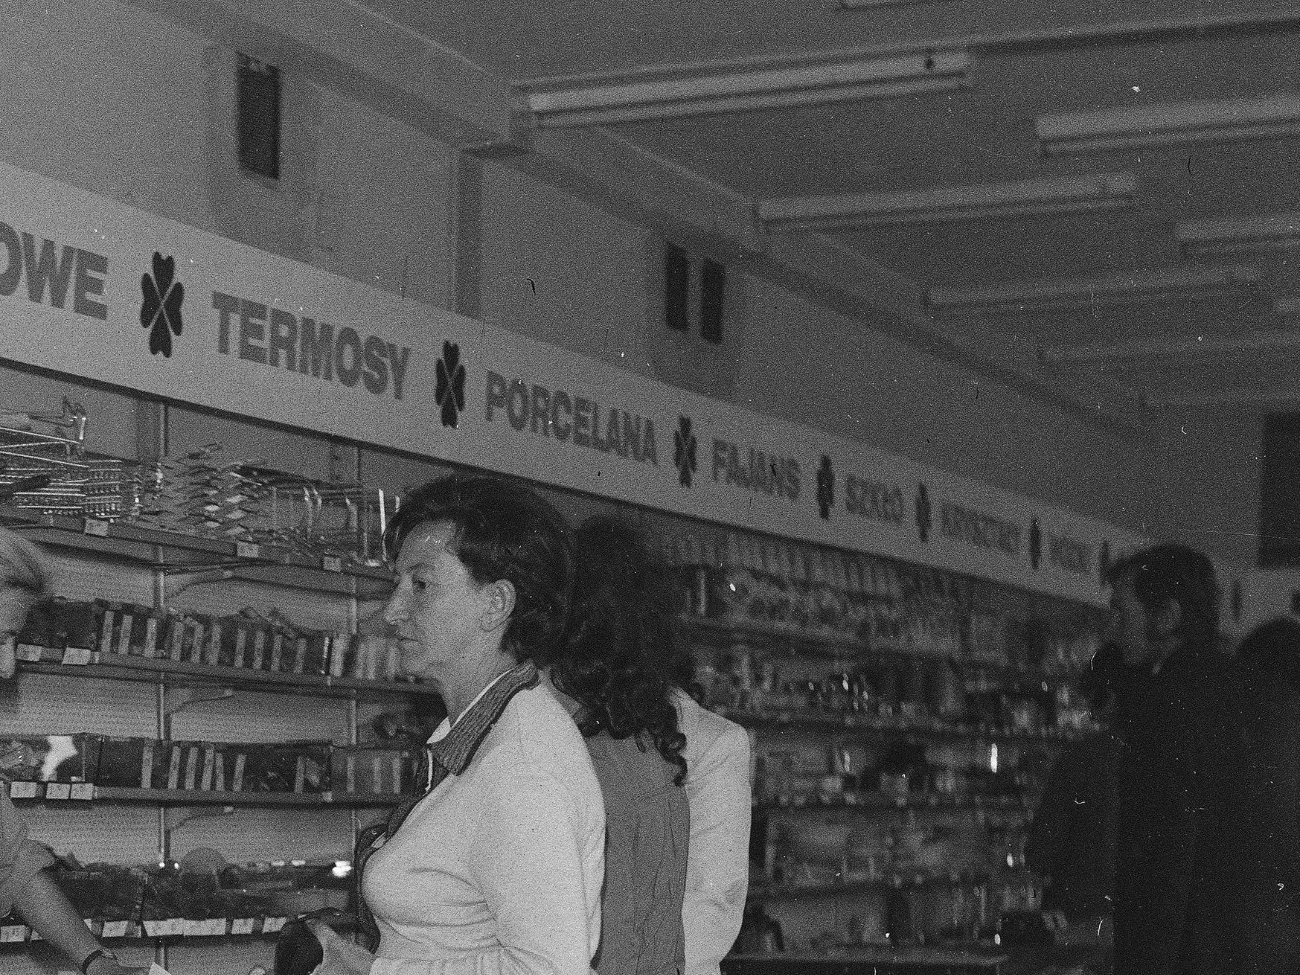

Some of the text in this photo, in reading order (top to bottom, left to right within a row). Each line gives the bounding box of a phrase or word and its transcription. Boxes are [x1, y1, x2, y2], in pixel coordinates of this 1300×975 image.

[212, 290, 412, 401] TERMOSY
[485, 369, 659, 468] PORCELANA
[711, 437, 801, 503] FAJANS
